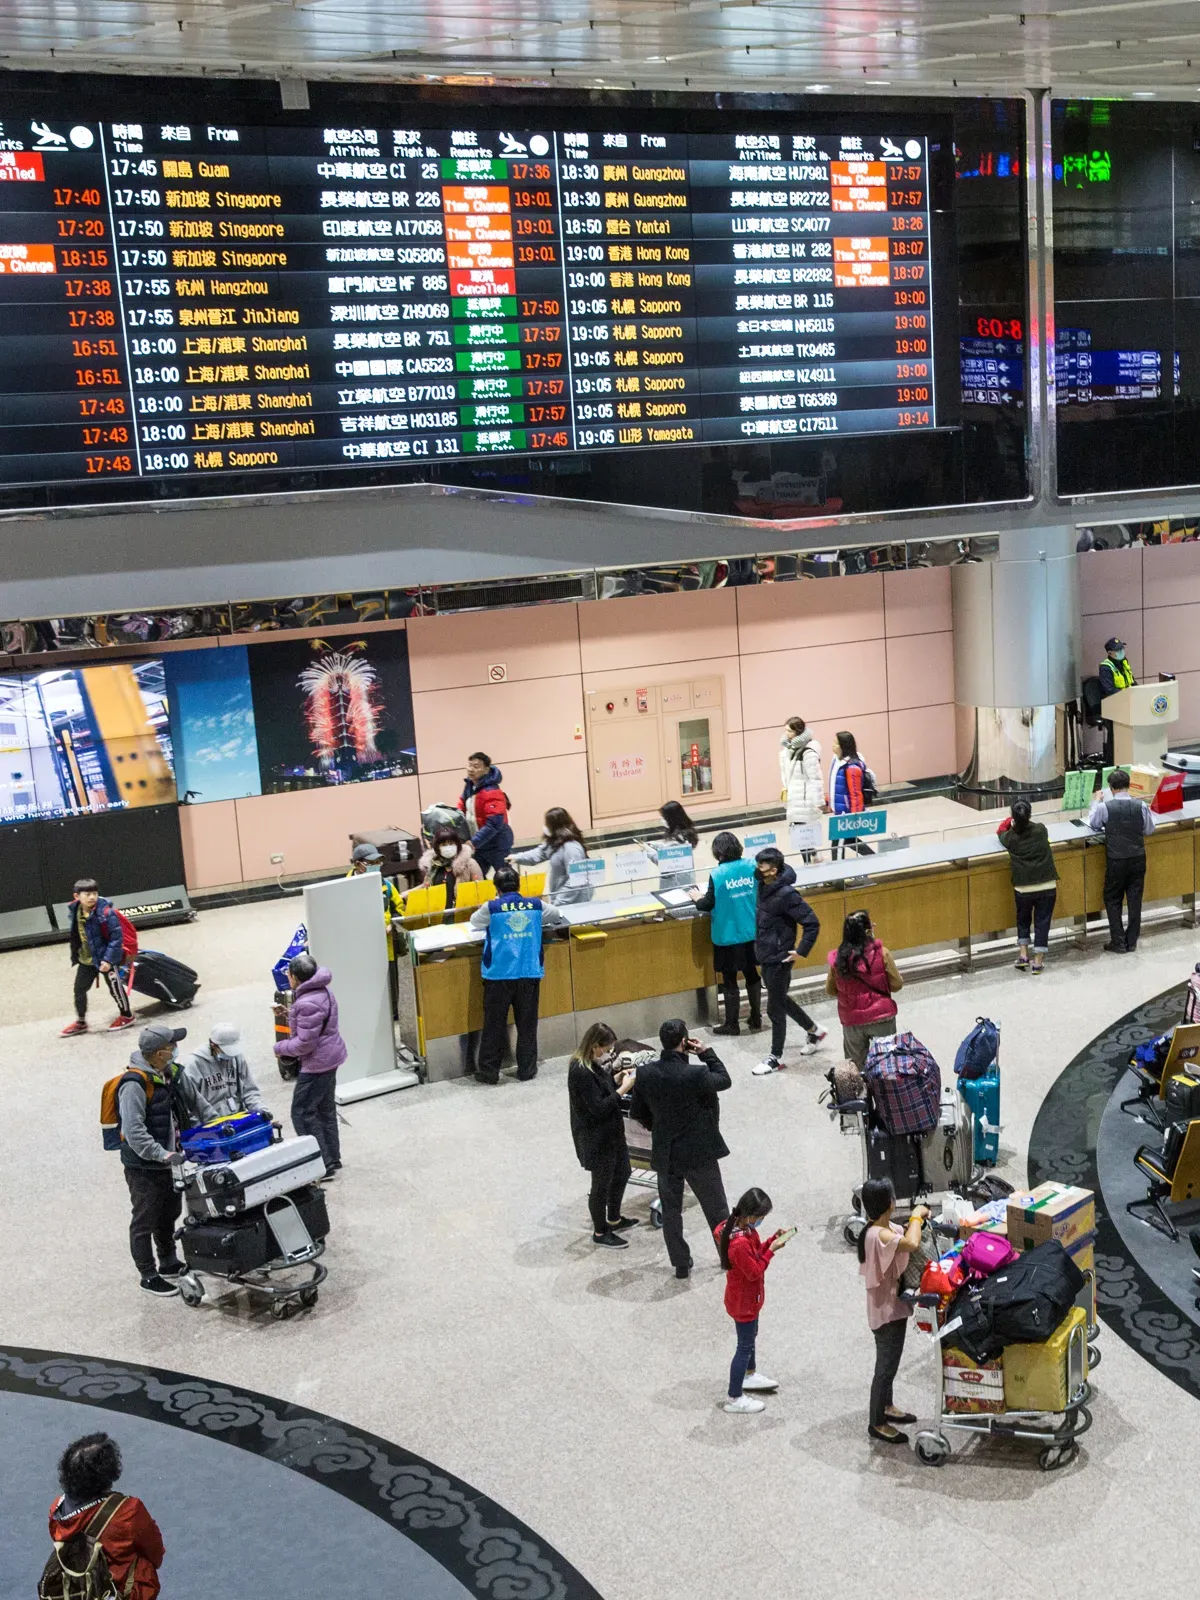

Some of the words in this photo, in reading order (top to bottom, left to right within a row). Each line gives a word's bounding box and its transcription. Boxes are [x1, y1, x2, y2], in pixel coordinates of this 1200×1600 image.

[112, 124, 143, 139] 時間
[161, 125, 191, 140] 來自
[208, 127, 238, 141] From
[641, 134, 666, 147] From
[113, 141, 143, 153] Time
[329, 145, 380, 157] Airlines
[394, 146, 423, 158] Flight
[450, 147, 493, 158] Remarks
[111, 159, 157, 176] 17:45
[199, 162, 229, 177] Guam
[317, 162, 388, 179] 中華航空
[390, 163, 406, 178] CI
[421, 163, 438, 179] 25
[513, 164, 550, 179] 17:36
[562, 165, 598, 179] 18:30
[604, 165, 627, 181] 廣州
[632, 166, 685, 181] Guangzhou
[788, 166, 828, 180] HU7981
[891, 166, 921, 180] 17:57
[54, 189, 100, 205] 17:40
[115, 189, 160, 206] 17:50
[166, 190, 211, 207] 新加坡
[216, 192, 281, 208] Singapore
[320, 191, 390, 207] 長榮航空
[392, 191, 409, 207] BR
[416, 192, 440, 207] 226
[515, 192, 552, 206] 19:01
[58, 220, 104, 236] 17:20
[118, 220, 163, 236] 17:50
[169, 221, 214, 237] 新加坡
[219, 222, 284, 238] Singapore
[323, 220, 393, 236] 印度航空
[395, 220, 442, 235] AI7058
[566, 219, 602, 234] 18:50
[636, 220, 670, 233] Yantai
[732, 217, 789, 233] 山東航空
[791, 217, 830, 232] SC4077
[892, 217, 923, 230] 18:26
[61, 250, 108, 266] 18:15
[567, 246, 603, 261] 19:00
[608, 246, 632, 261] 香港
[637, 246, 661, 261] Hong
[665, 246, 689, 260] Kong
[893, 241, 923, 255] 18:07
[10, 260, 54, 273] Change
[65, 280, 111, 296] 17:38
[125, 279, 170, 295] 17:55
[176, 279, 205, 296] 杭州
[211, 280, 268, 296] Hangzhou
[422, 275, 447, 290] 885
[457, 282, 509, 295] Cancelled
[128, 309, 173, 325] 17:55
[243, 308, 299, 324] JinJiang
[330, 304, 400, 321] 深圳航空
[402, 303, 449, 319] ZH9069
[523, 301, 559, 315] 17:50
[571, 299, 607, 314] 19:05
[611, 299, 635, 314] 札幌
[640, 299, 681, 313] Sapporo
[69, 311, 114, 326] 17:38
[795, 318, 834, 333] NH5815
[73, 340, 118, 356] 16:51
[132, 338, 176, 355] 18:00
[183, 336, 246, 354] 上海/浦東
[252, 336, 307, 352] Shanghai
[524, 327, 560, 342] 17:57
[796, 343, 835, 357] TK9465
[135, 367, 179, 383] 18:00
[186, 365, 249, 382] 上海/浦東
[255, 364, 309, 380] Shanghai
[406, 357, 453, 373] CA5523
[797, 368, 836, 383] NZ4911
[338, 387, 406, 404] 立榮航空
[408, 385, 455, 401] B77019
[798, 392, 837, 407] TG6369
[80, 399, 125, 415] 17:43
[340, 414, 408, 432] 吉祥航空
[579, 429, 614, 445] 19:05
[619, 428, 642, 443] 山形
[647, 426, 693, 441] Yamagata
[799, 416, 838, 432] CI7511
[896, 410, 929, 425] 19:14
[145, 453, 188, 470] 18:00
[194, 452, 223, 468] 札幌
[229, 452, 277, 466] Sapporo
[413, 440, 428, 455] CI
[435, 438, 460, 453] 131
[532, 432, 567, 447] 17:45
[86, 456, 131, 472] 17:43
[612, 767, 642, 778] Hydrant
[5, 813, 25, 821] who
[28, 810, 51, 818] have
[54, 804, 92, 814] checked
[107, 800, 130, 808] early
[837, 816, 878, 833] kkday
[725, 875, 754, 890] kkday
